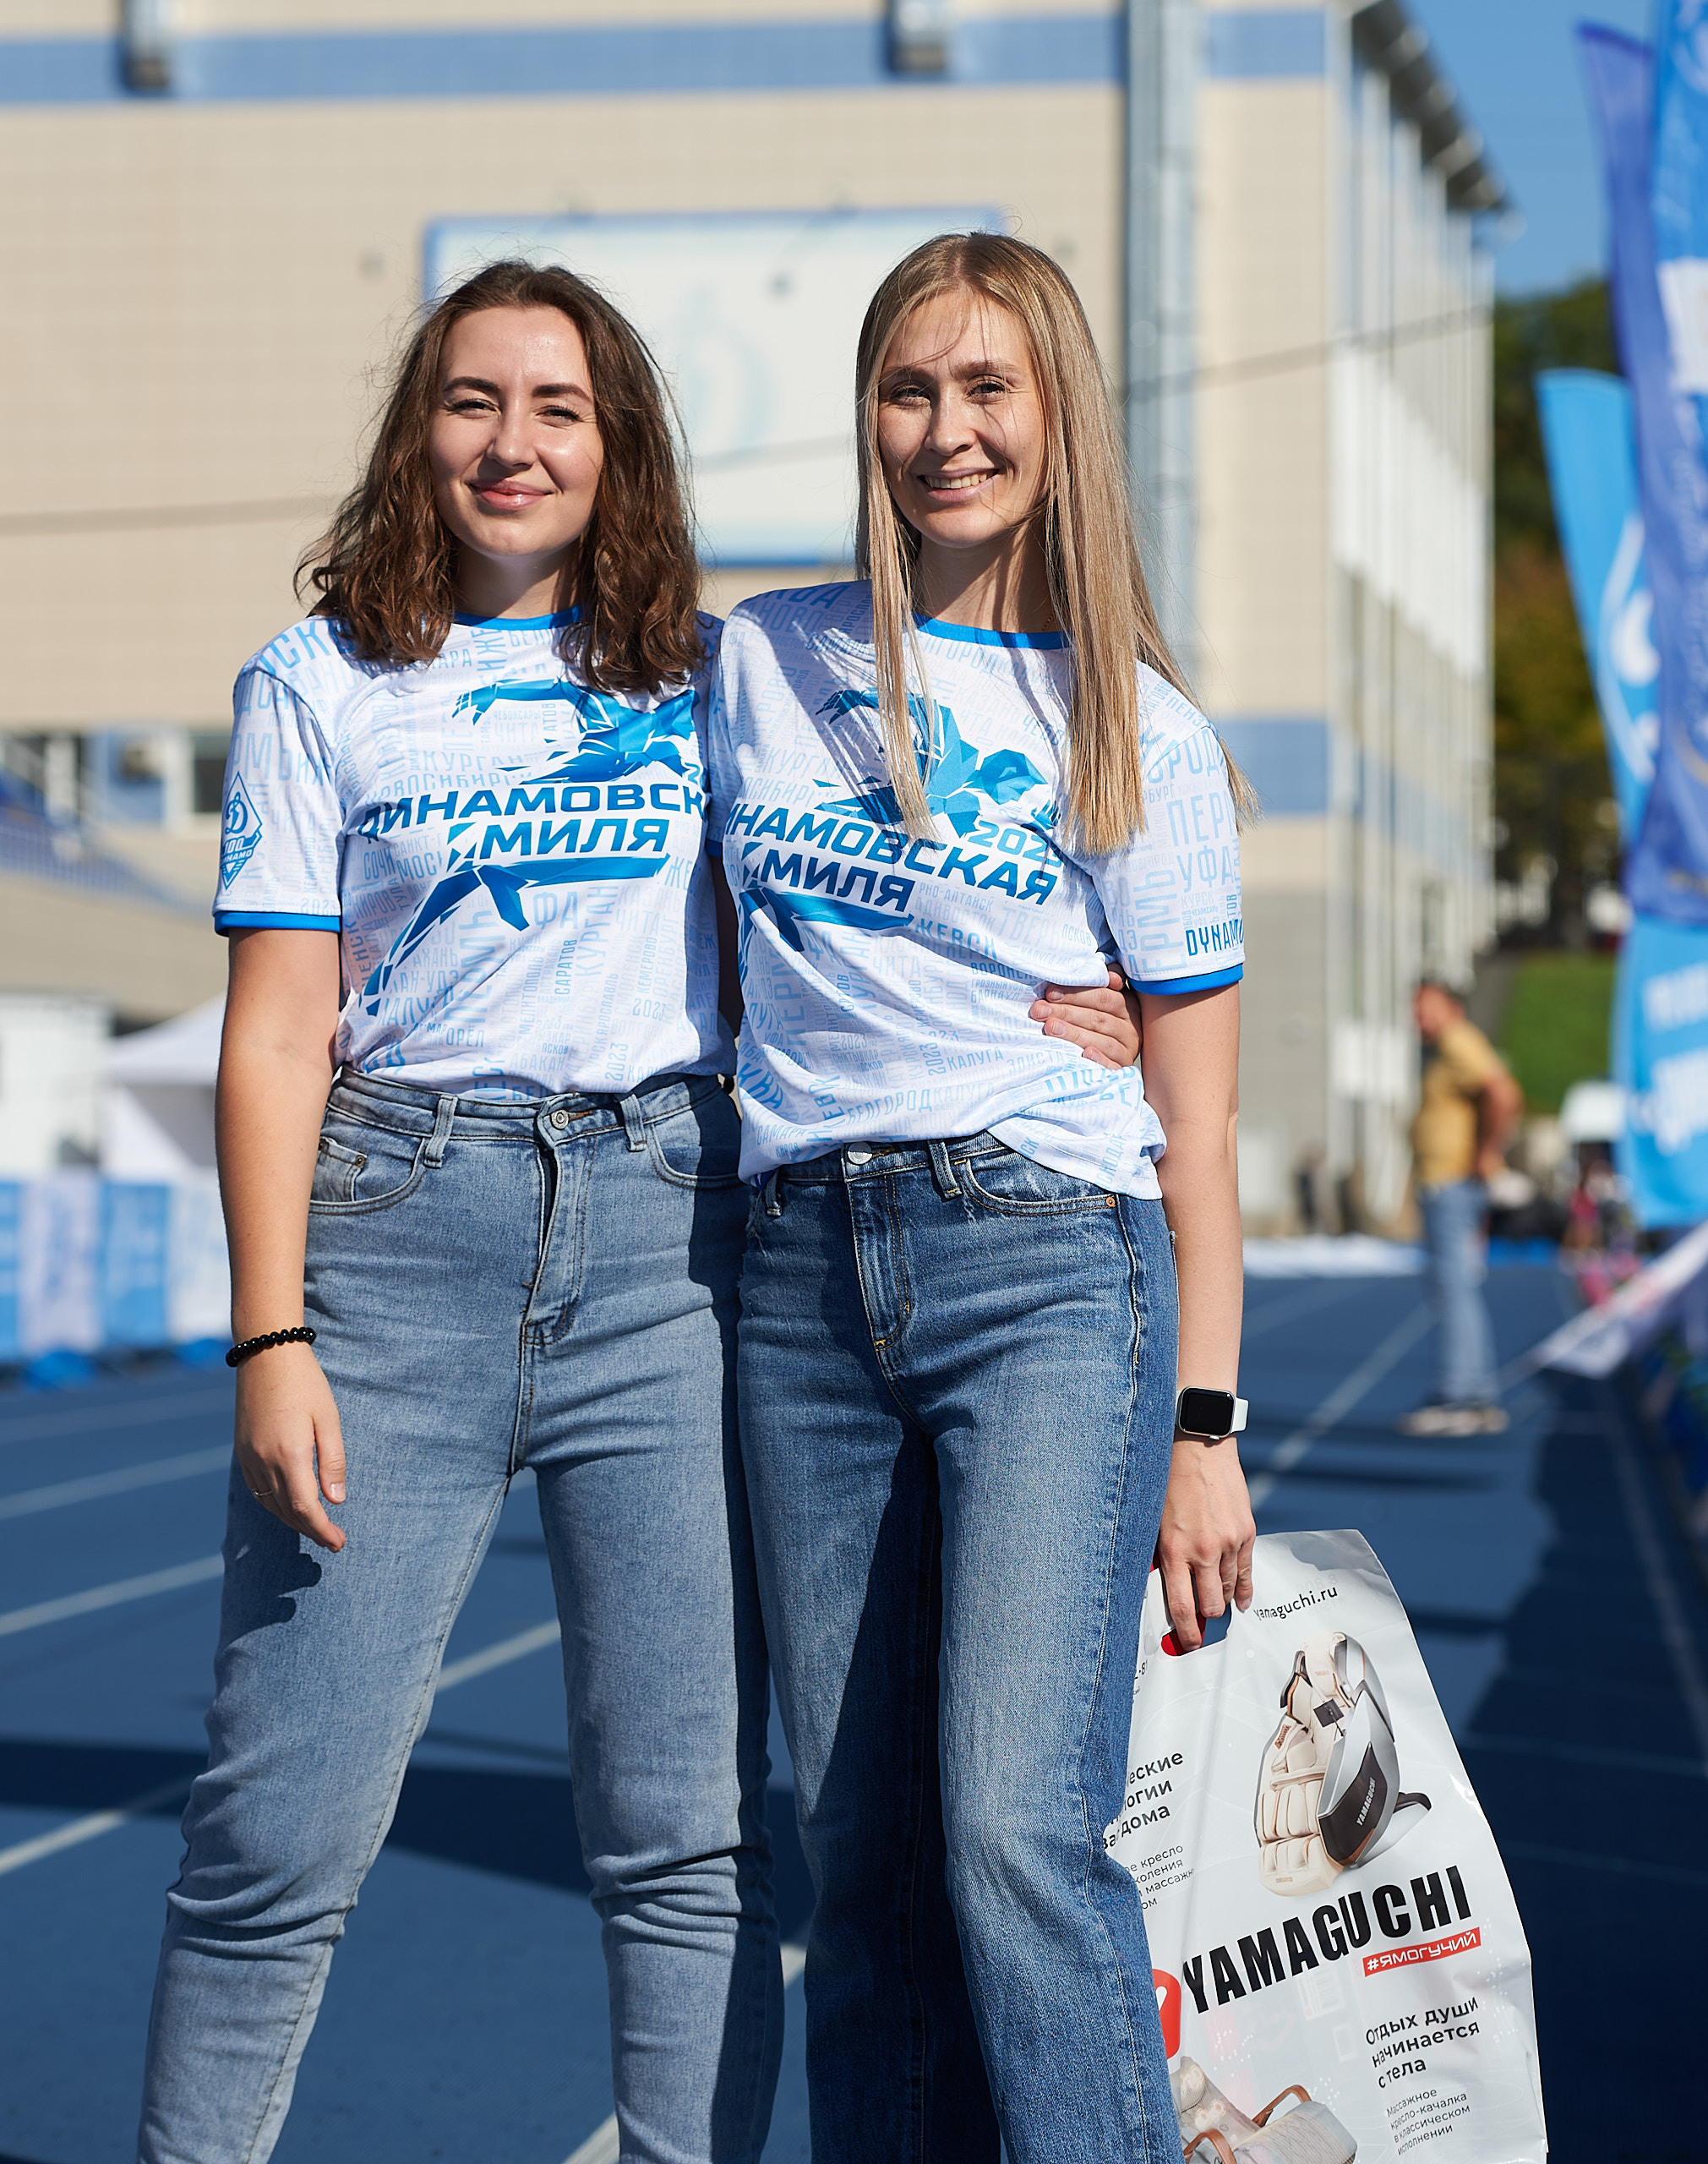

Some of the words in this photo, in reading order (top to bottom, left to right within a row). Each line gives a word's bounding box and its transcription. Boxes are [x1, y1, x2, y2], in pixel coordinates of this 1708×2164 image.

[1166, 697, 1205, 728] ПЕНЗ
[224, 837, 245, 853] 100
[479, 819, 669, 861] МИЛЯ
[363, 847, 396, 880] СОЧИ
[1176, 846, 1236, 893] УФА
[762, 853, 914, 912] МИЛЯ
[919, 883, 994, 911] РНО-АЛТАЙСК
[532, 892, 579, 930] ФА
[1133, 870, 1187, 974] ЕРМЬ
[575, 886, 619, 978] КУРГАН
[916, 918, 999, 959] ЖЕВСК
[1061, 923, 1092, 947] ПСКОВ
[554, 939, 577, 995] САРАТОВ
[636, 937, 657, 994] КЕМЕРОВО
[518, 956, 544, 1035] МЕЛИТОПОЛЬ
[597, 973, 619, 1035] ЯРОСЛАВЛЬ
[446, 1025, 485, 1048] ОРЁЛ
[542, 1043, 569, 1055] ПСКОВ
[605, 1041, 629, 1080] 2023
[919, 1042, 946, 1075] 2023
[947, 1047, 1004, 1071] КАЛУГА
[847, 1089, 932, 1124] БЕЛГОРОД
[1253, 1587, 1338, 1620] yamaguchi.ru
[1127, 1752, 1183, 1786] еские
[1124, 1780, 1173, 1811] огии
[1356, 1777, 1377, 1826] YAMAGUCHI
[1121, 1805, 1170, 1838] дома
[1135, 1860, 1183, 1883] коления
[1140, 1845, 1183, 1868] кресло
[1145, 1867, 1194, 1894] массажн
[1142, 1898, 1158, 1910] ом
[1183, 1865, 1471, 2014] YAMAGUCHI
[1367, 1930, 1477, 1971] #ЯМОГУЧИЙ
[1366, 2014, 1419, 2045] Отдых
[1425, 1997, 1478, 2025] души
[1372, 2022, 1480, 2068] начинается
[1378, 2076, 1386, 2089] с
[1386, 2058, 1427, 2083] тела
[1386, 2089, 1438, 2118] Массажное
[1391, 2093, 1467, 2130] кресло-качалка
[1394, 2134, 1400, 2143] в
[1400, 2104, 1471, 2139] классическом
[1398, 2124, 1453, 2156] исполнении
